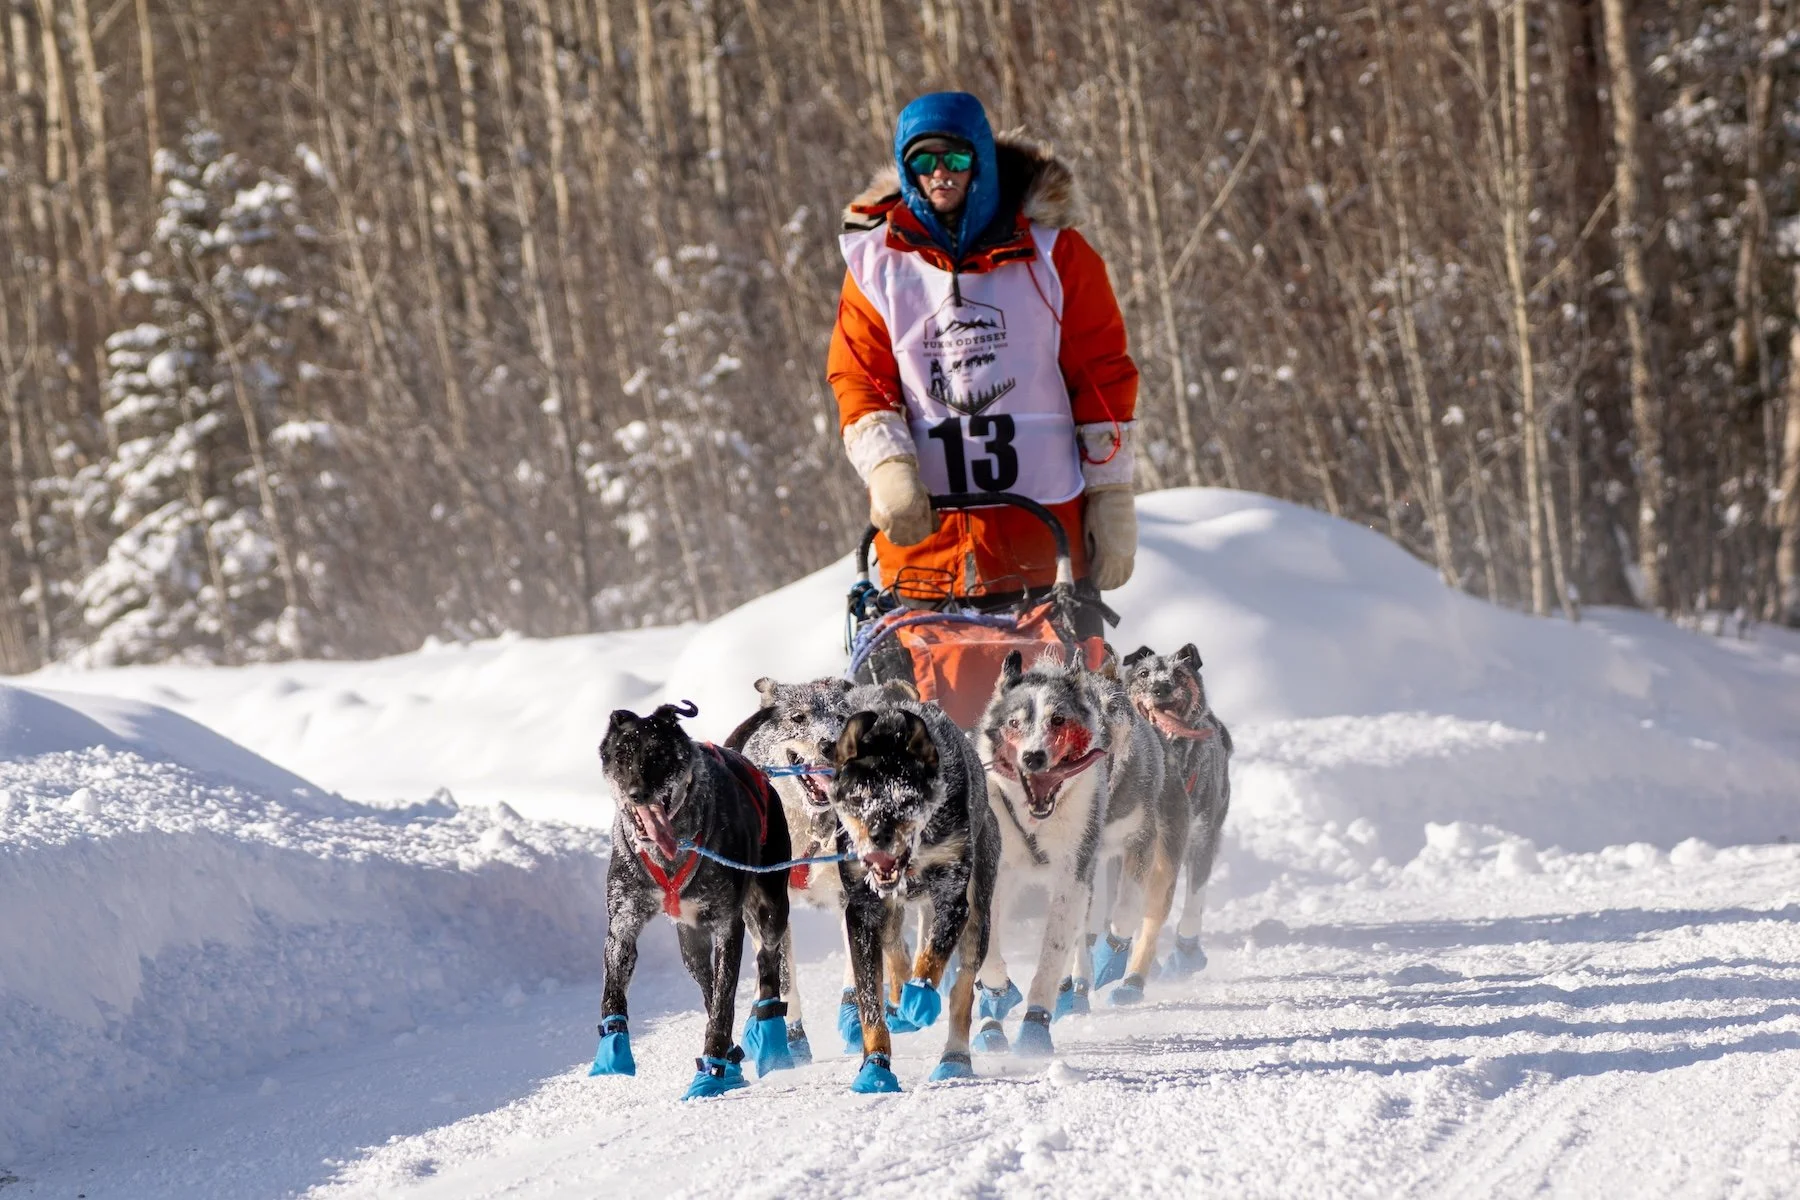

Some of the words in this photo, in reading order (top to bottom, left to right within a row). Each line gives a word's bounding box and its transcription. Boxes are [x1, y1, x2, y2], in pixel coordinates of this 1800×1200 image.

[923, 341, 952, 349] YUKN
[956, 332, 1006, 346] ODYSSEY
[928, 414, 1018, 493] 13
